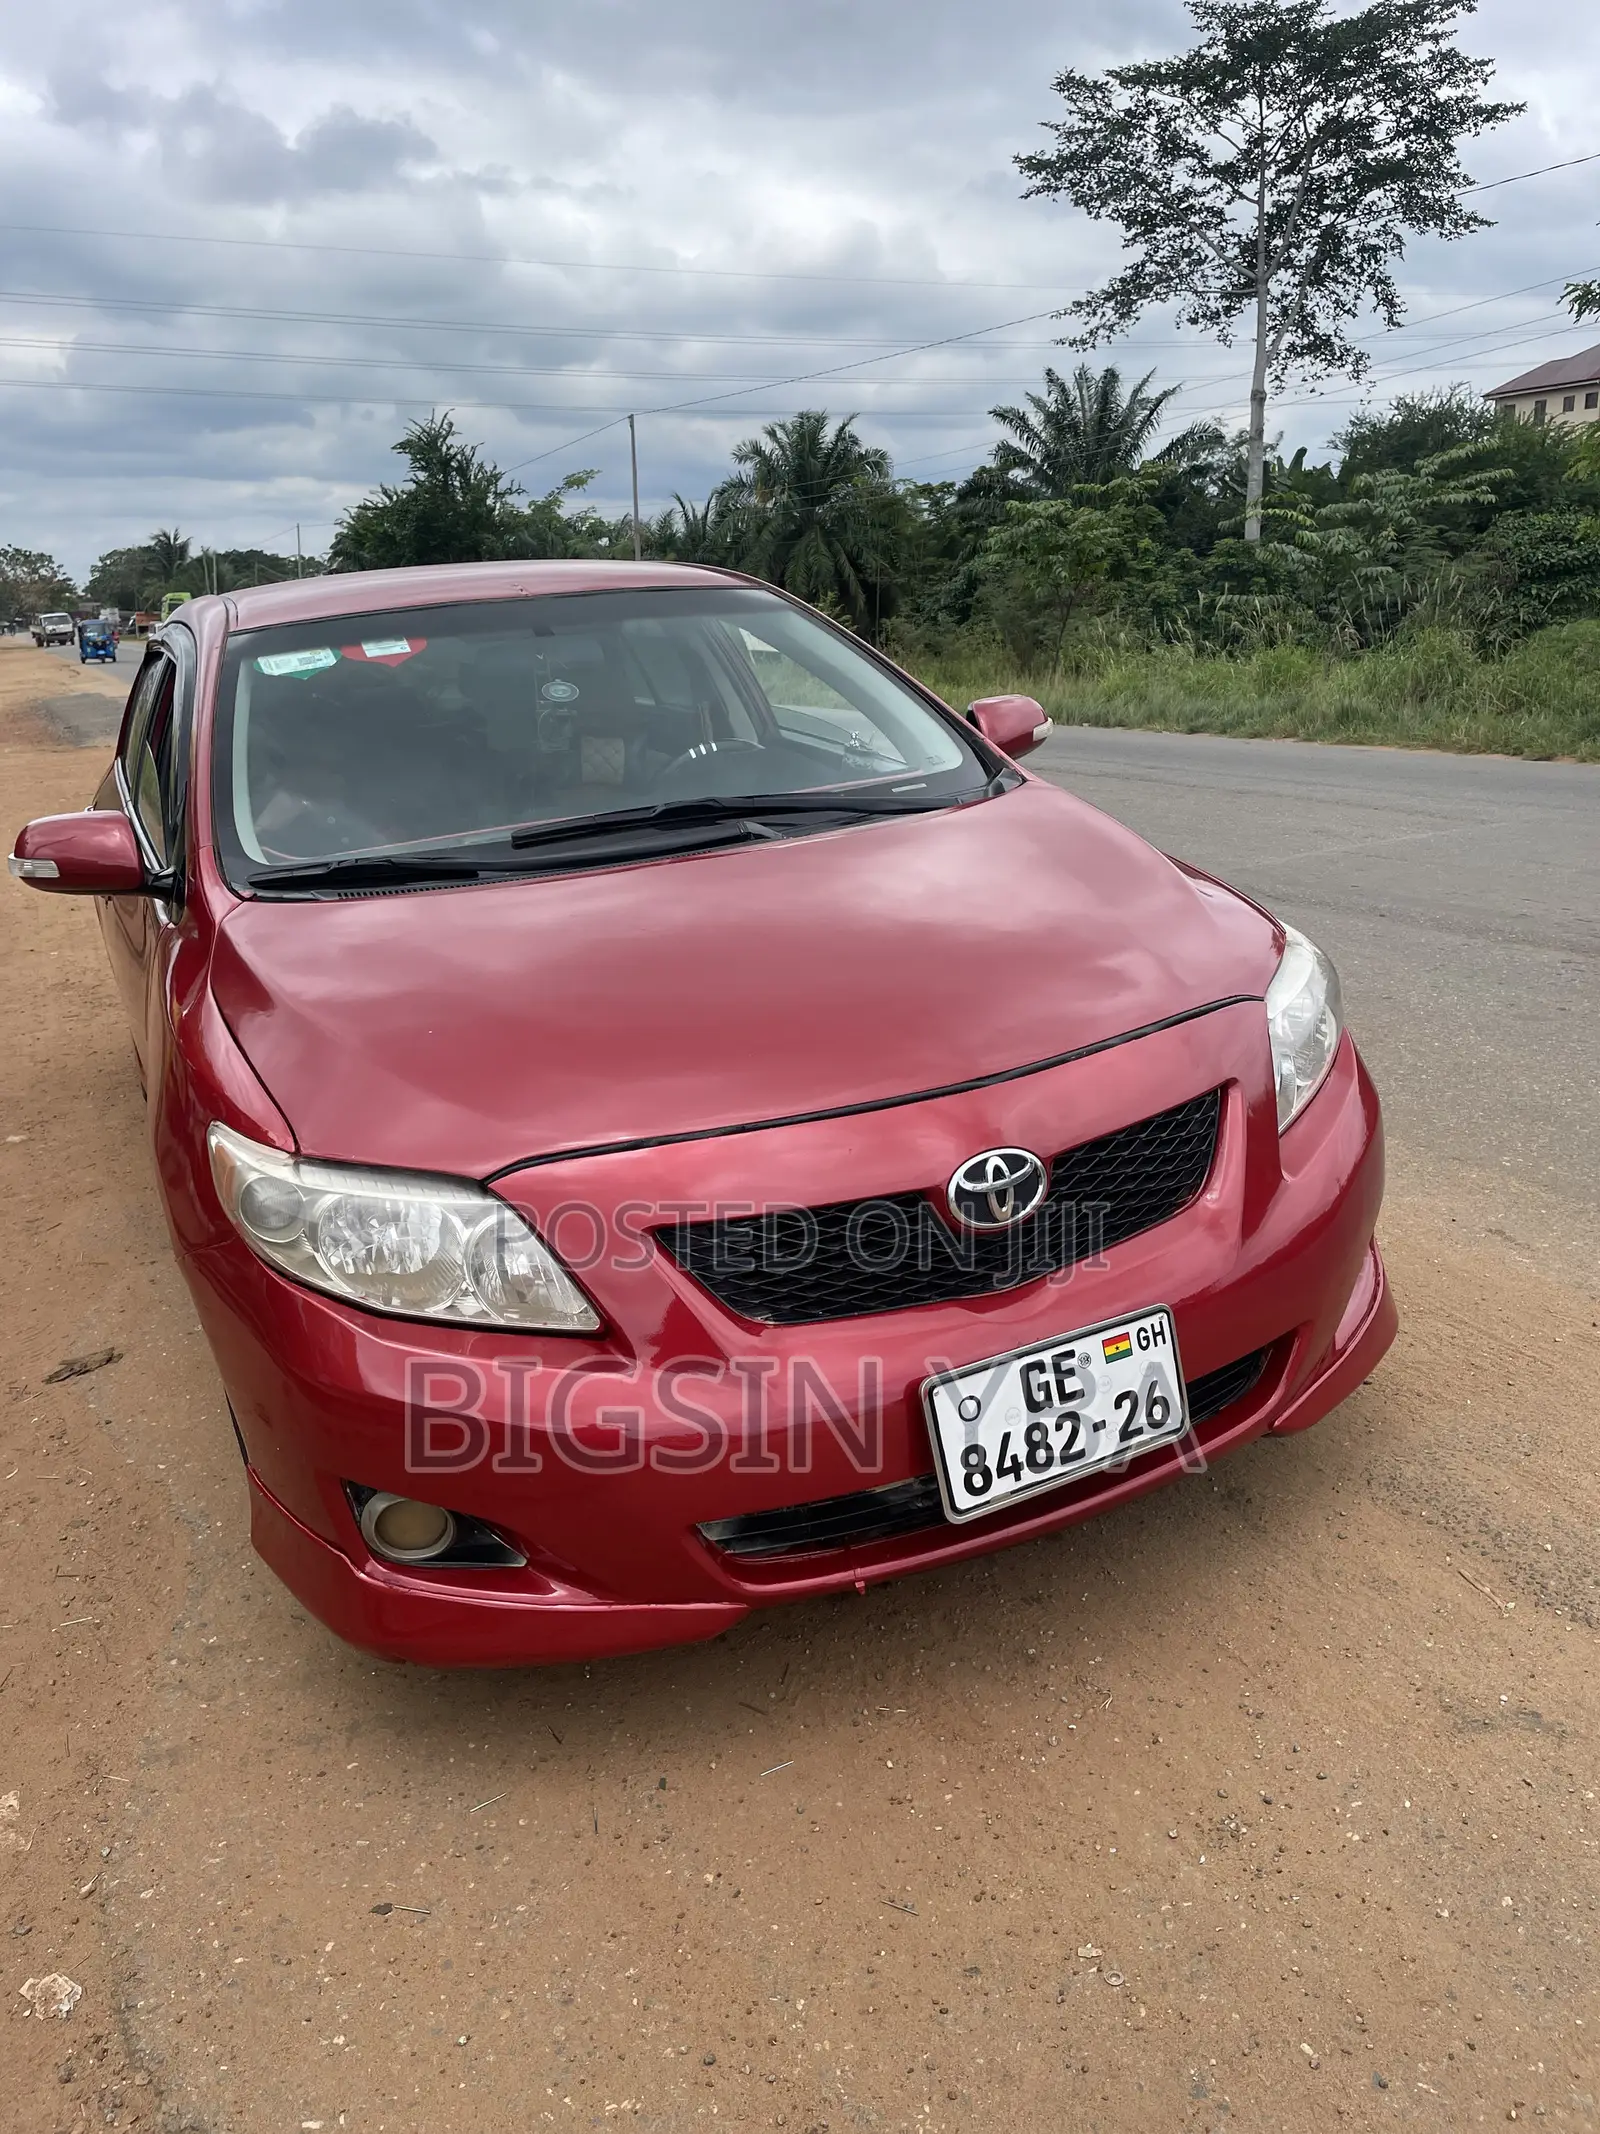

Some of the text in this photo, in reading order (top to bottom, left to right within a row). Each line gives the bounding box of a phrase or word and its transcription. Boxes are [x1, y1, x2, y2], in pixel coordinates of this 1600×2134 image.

[1136, 1320, 1167, 1351] GH
[1020, 1350, 1085, 1413] GE
[960, 1380, 1170, 1496] 8482-26
